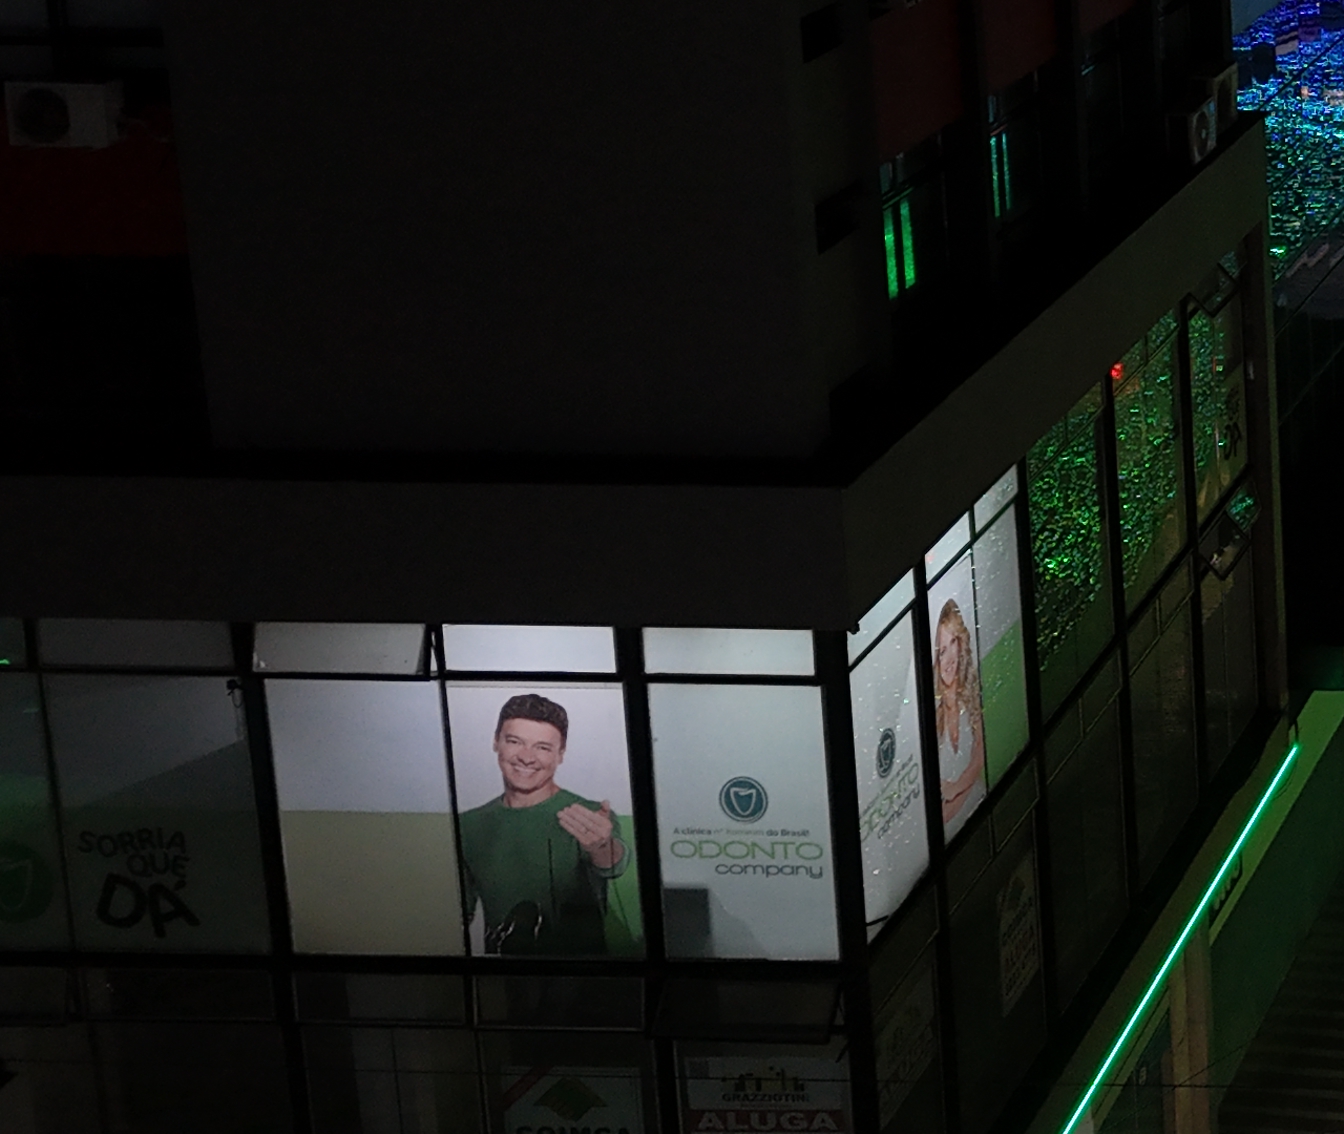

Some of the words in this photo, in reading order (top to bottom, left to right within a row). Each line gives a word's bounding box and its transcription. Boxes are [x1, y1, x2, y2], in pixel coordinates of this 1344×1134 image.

[78, 827, 186, 858] SORRIA
[670, 840, 824, 861] ODONTO
[127, 851, 190, 878] QUE
[715, 863, 823, 879] company
[97, 872, 200, 938] DÁ
[697, 1110, 840, 1132] ALUGA
